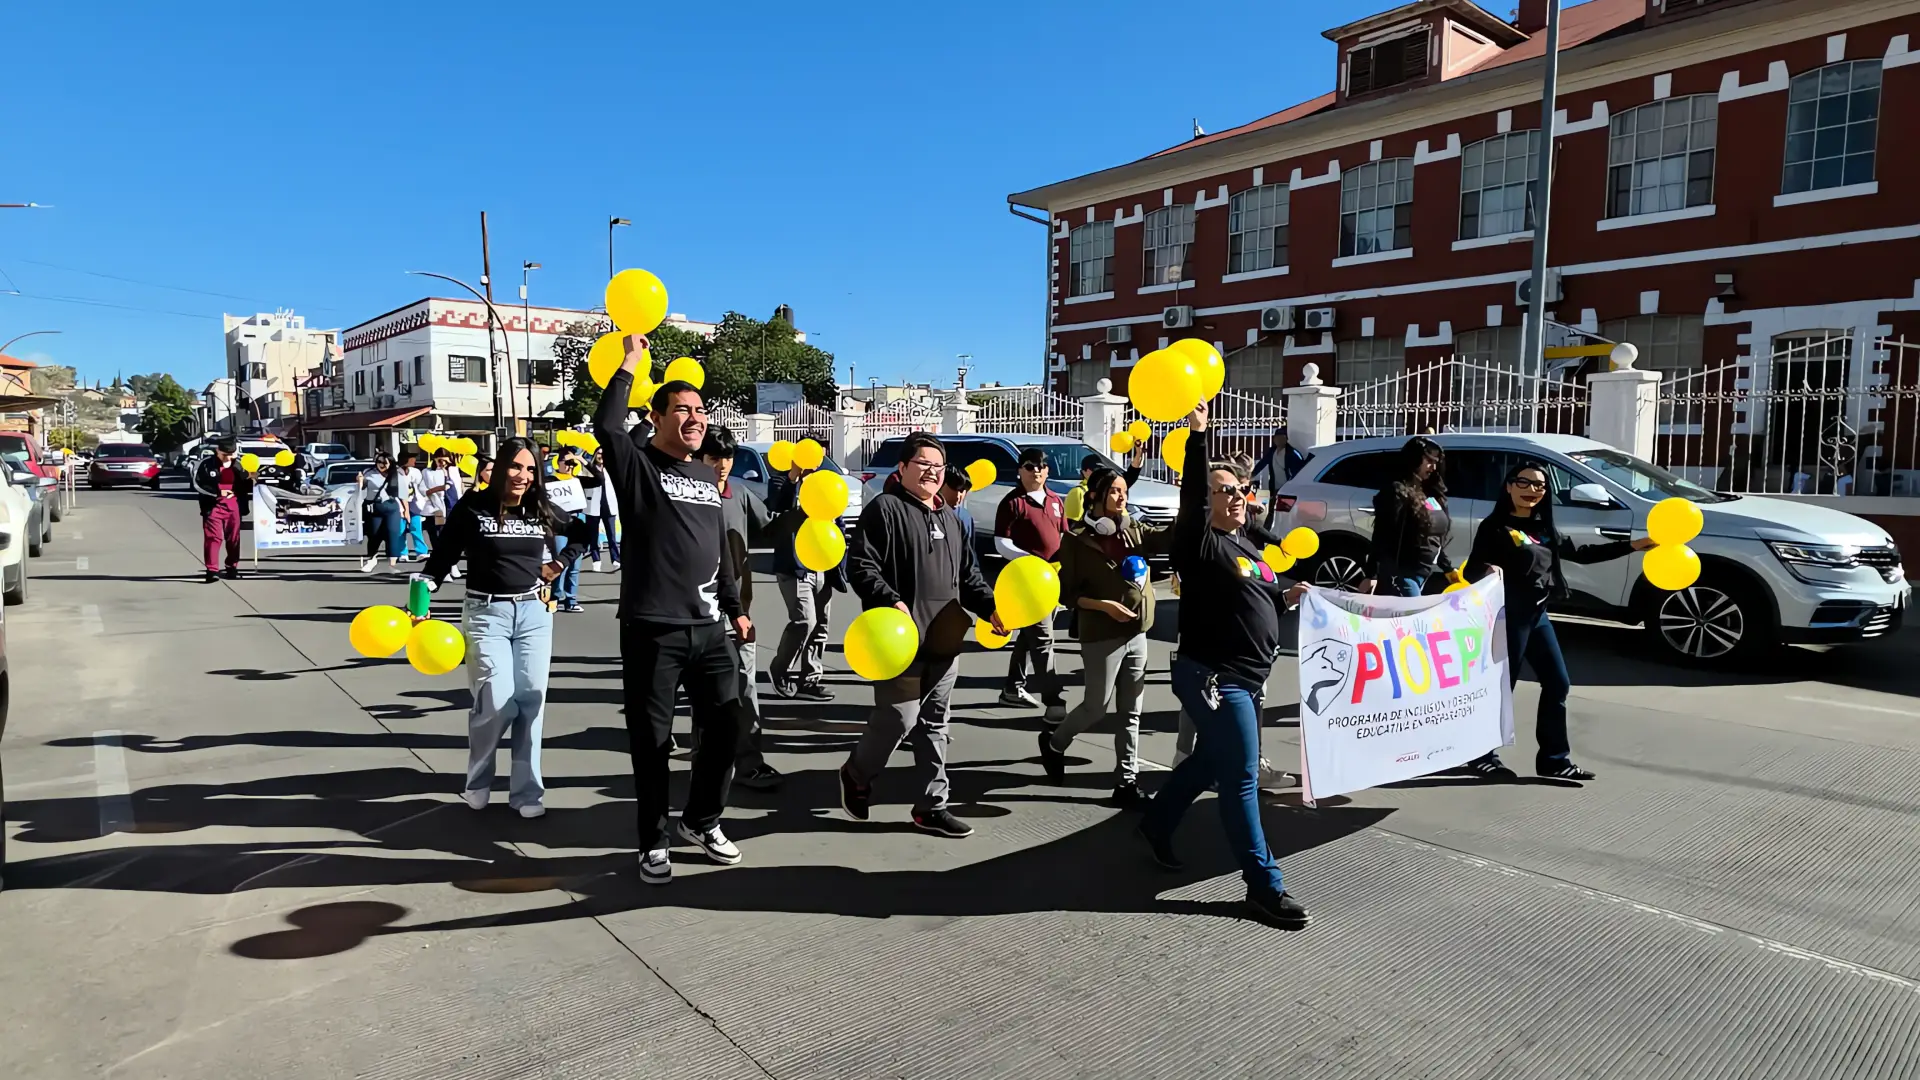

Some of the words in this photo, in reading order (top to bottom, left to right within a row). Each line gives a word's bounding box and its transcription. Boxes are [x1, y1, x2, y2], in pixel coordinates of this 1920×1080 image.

[1328, 712, 1388, 730] PROGRAMA
[1389, 709, 1402, 721] DE
[1356, 720, 1410, 739] EDUCATIVA
[1412, 718, 1423, 731] EN
